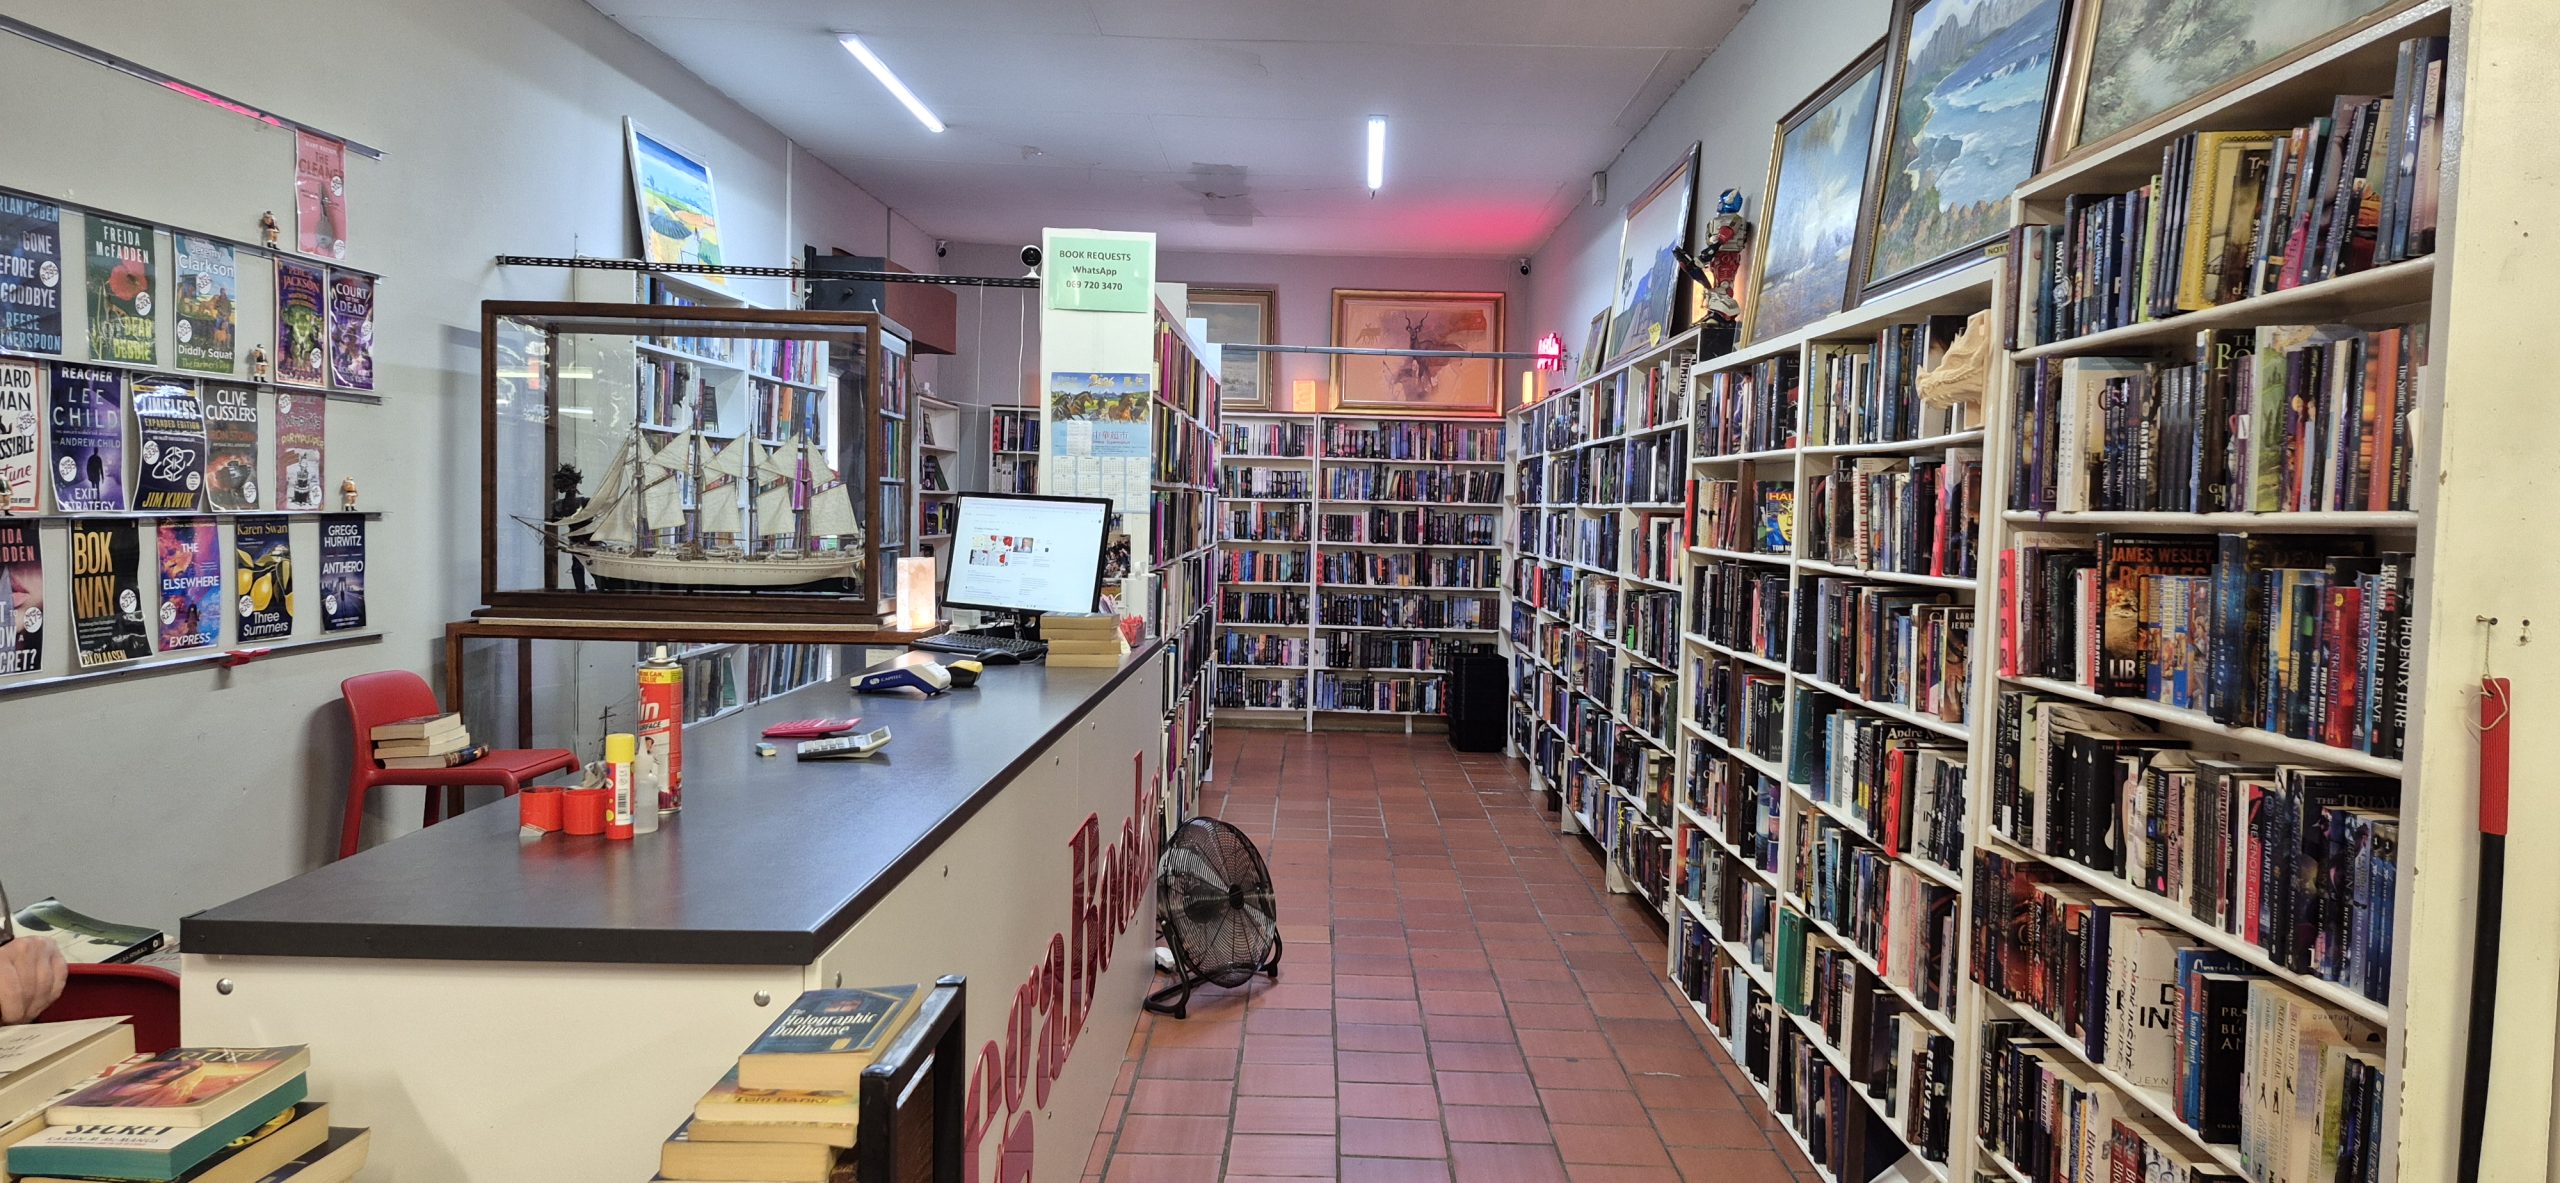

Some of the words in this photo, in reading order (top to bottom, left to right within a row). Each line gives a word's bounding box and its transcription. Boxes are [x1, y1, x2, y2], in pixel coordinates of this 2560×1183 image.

[2363, 122, 2375, 152] FREDERIK
[2360, 153, 2368, 170] POHL
[2280, 177, 2293, 214] VAMPIRE
[26, 202, 59, 222] COBEN
[23, 231, 53, 254] GONE
[103, 226, 140, 246] FREIDA
[95, 241, 149, 264] McFADDEN
[191, 245, 222, 259] Jeremy
[1059, 250, 1084, 260] BOOK
[1087, 250, 1131, 262] REQUESTS
[1987, 244, 2004, 256] NOT
[179, 255, 234, 278] Clarkson
[1072, 265, 1117, 277] WhatsApp
[1, 283, 56, 308] GOODBYE
[282, 277, 320, 294] JACKSON
[336, 282, 368, 299] COURT
[1084, 281, 1100, 290] 720
[1101, 281, 1123, 291] 3470
[339, 300, 365, 315] DEAD
[6, 312, 40, 330] REESE
[124, 316, 153, 337] DEAR
[113, 338, 151, 360] DEBBIE
[178, 345, 205, 358] Diddly
[208, 348, 233, 360] Squat
[62, 367, 113, 382] REACHER
[1679, 358, 1691, 398] SPACEMAN
[2399, 363, 2408, 379] The
[68, 387, 104, 405] LEE
[217, 390, 248, 406] CLIVE
[2356, 384, 2364, 406] Amber
[2397, 381, 2407, 407] Subtle
[53, 407, 118, 429] CHILD
[143, 398, 197, 419] LIMITLESS
[145, 418, 176, 429] EXPANDED
[177, 420, 200, 430] EDITION
[2353, 408, 2361, 436] Spyglass
[2393, 412, 2405, 435] Knife
[60, 437, 95, 447] ANDREW
[98, 438, 121, 449] CHILD
[2139, 420, 2150, 480] GANYMEDE
[2351, 451, 2359, 471] Philip
[2393, 446, 2403, 467] Philip
[75, 488, 98, 500] EXIT
[2349, 473, 2358, 504] Pullman
[2392, 470, 2402, 502] Pullman
[142, 492, 163, 507] JIM
[164, 493, 195, 508] KWIK
[237, 523, 262, 535] Karen
[265, 524, 288, 535] Swan
[328, 524, 358, 536] GREGG
[181, 543, 199, 553] THE
[324, 536, 362, 548] HURWITZ
[74, 532, 113, 574] BOK
[2111, 547, 2153, 562] JAMES
[2159, 550, 2214, 564] WESLEY,
[322, 560, 364, 574] ANTIHERO
[2001, 558, 2008, 577] R
[2387, 565, 2397, 589] HERE
[163, 575, 220, 590] ELSEWHERE
[2262, 574, 2271, 607] PHILIP
[2379, 565, 2388, 609] ARTHUR
[75, 575, 115, 619] WAY
[2001, 588, 2008, 607] R
[2361, 581, 2371, 633] UTTERLY
[253, 611, 280, 624] Three
[2001, 618, 2008, 637] R
[2261, 608, 2270, 638] REEVE
[169, 632, 211, 647] EXPRESS
[243, 622, 289, 637] Summers
[2359, 639, 2369, 671] DARK
[2375, 621, 2387, 672] PHILIP
[2397, 616, 2412, 687] PHOENIX
[2001, 648, 2008, 667] R
[2289, 650, 2299, 693] STARCROSS
[2319, 667, 2327, 694] PHILIP
[2329, 635, 2340, 705] LARKLIGHT
[2308, 695, 2316, 721] REEVE
[2318, 697, 2326, 723] REEVE
[2373, 680, 2384, 723] REEVE
[2394, 692, 2408, 727] FIRE
[1888, 728, 1923, 739] Andre
[2146, 771, 2156, 796] ANNE
[2157, 775, 2166, 797] ANNE
[2157, 798, 2165, 815] RICE
[2169, 786, 2177, 809] ANNE
[2316, 797, 2337, 805] THE
[2156, 843, 2164, 872] VIOLIN
[2248, 824, 2259, 882] REVENGER
[2263, 840, 2272, 883] ATLANTIS
[2354, 935, 2362, 975] RIORDAN
[792, 1008, 806, 1016] The
[2175, 992, 2185, 1020] Crystal
[782, 1011, 878, 1028] Holographic
[2189, 1015, 2198, 1037] Song
[2276, 1005, 2285, 1045] KEEPING
[770, 1024, 850, 1038] Dollhouse
[2288, 1012, 2297, 1050] SELLING
[2189, 1039, 2197, 1064] Quest
[2274, 1059, 2282, 1080] REAL
[47, 1136, 89, 1144] KAREN
[66, 1125, 173, 1135] SECRET
